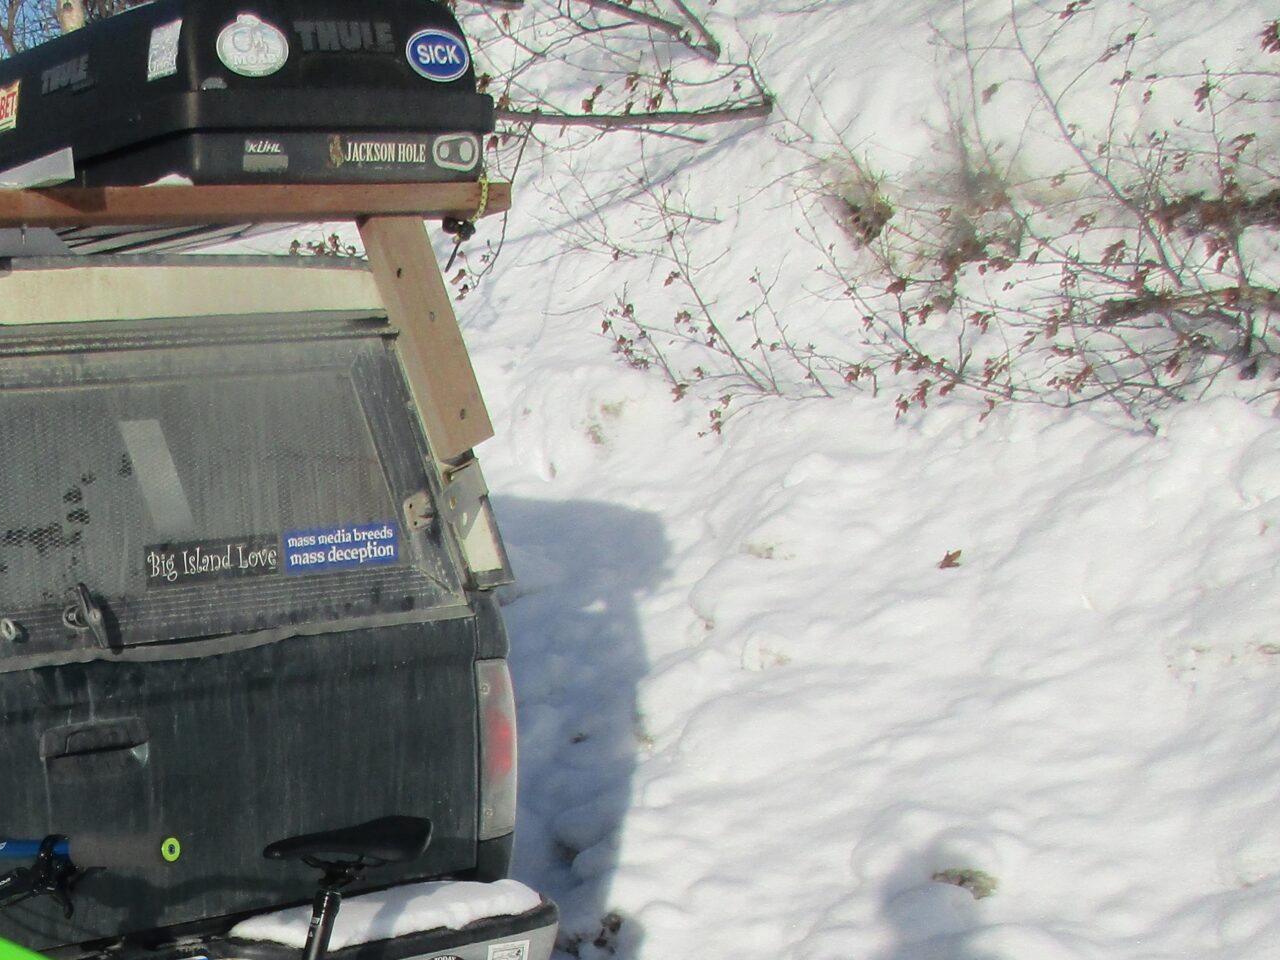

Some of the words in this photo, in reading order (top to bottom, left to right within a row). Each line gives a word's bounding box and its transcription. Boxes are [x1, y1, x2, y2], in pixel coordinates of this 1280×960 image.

[293, 20, 395, 52] THULE
[234, 54, 278, 65] MOAB
[417, 45, 461, 65] SICK
[344, 142, 397, 163] JACKSON
[398, 143, 426, 162] HOLE
[287, 536, 316, 548] mass
[318, 529, 352, 545] media
[353, 526, 393, 541] breeds
[147, 552, 178, 581] Big
[182, 545, 232, 575] Island
[237, 546, 277, 569] Love
[289, 551, 325, 566] mass
[328, 542, 394, 563] deception
